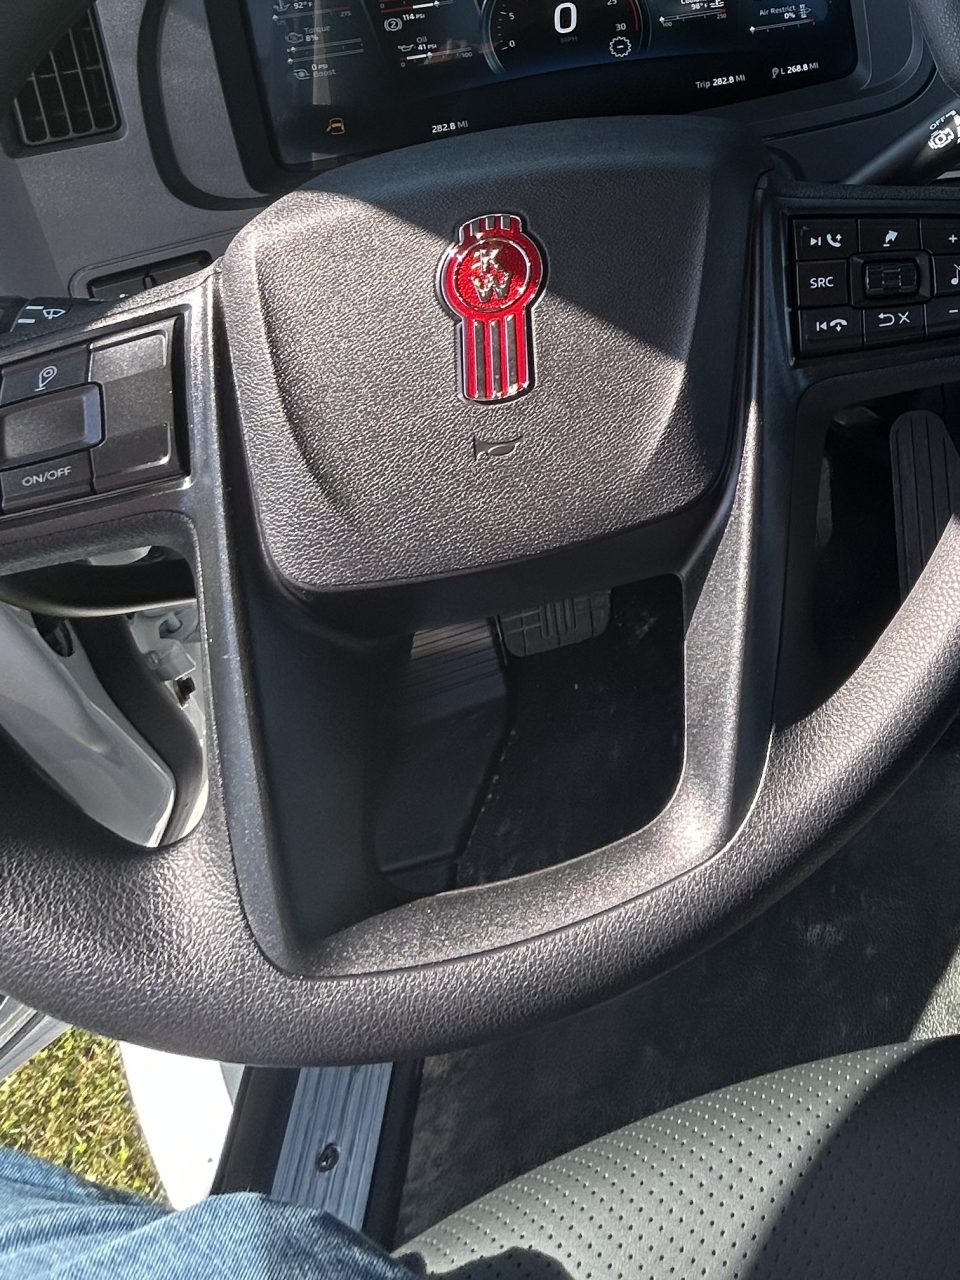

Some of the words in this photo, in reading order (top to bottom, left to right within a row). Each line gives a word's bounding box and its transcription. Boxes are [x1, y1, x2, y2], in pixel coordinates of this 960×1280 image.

[509, 12, 515, 20] 5
[760, 8, 769, 16] Air
[771, 5, 796, 14] Restrict
[402, 13, 415, 21] 114
[554, 2, 577, 34] 0
[304, 25, 331, 34] Torque
[616, 23, 627, 31] 30
[509, 40, 515, 48] 0
[560, 35, 578, 43] MPH
[313, 69, 337, 78] Boost
[787, 63, 809, 74] 268.8
[809, 62, 819, 70] MI
[696, 81, 711, 89] Trip
[713, 76, 735, 87] 282.8
[735, 74, 746, 82] MI
[432, 123, 456, 133] 282.8
[457, 120, 468, 128] MI
[473, 248, 499, 271] K
[471, 271, 511, 303] W
[810, 276, 834, 288] SRC
[21, 465, 72, 487] ON/OFF
